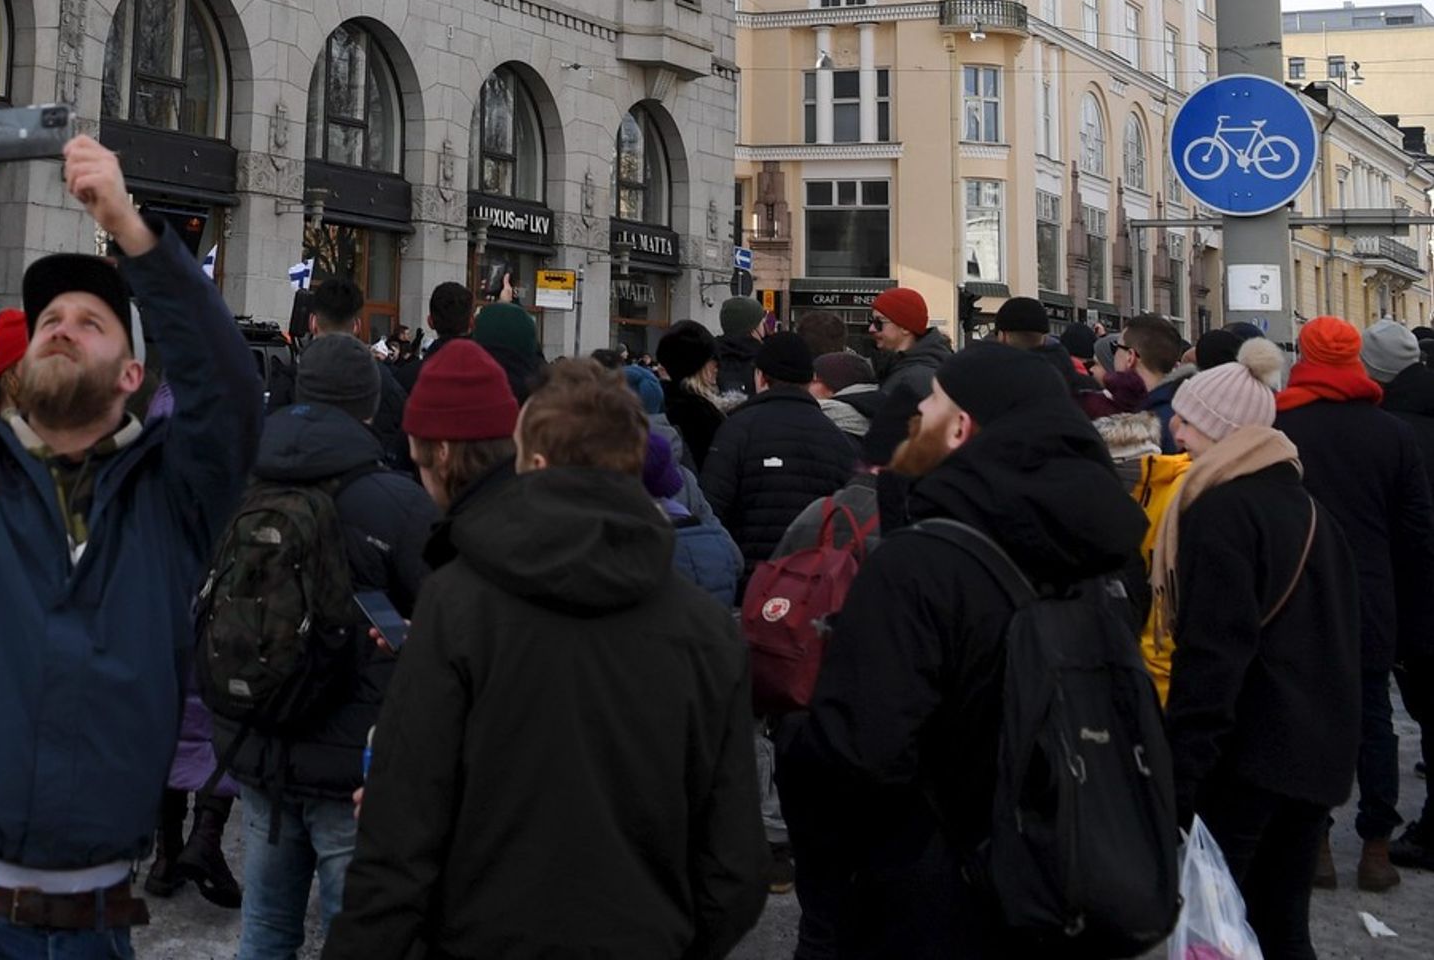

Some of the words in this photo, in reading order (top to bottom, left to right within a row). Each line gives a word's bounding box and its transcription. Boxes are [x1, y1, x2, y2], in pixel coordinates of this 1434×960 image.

[530, 214, 550, 235] LKV
[639, 233, 673, 256] MATTA
[619, 281, 656, 303] MATTA
[812, 294, 840, 305] CRAFT
